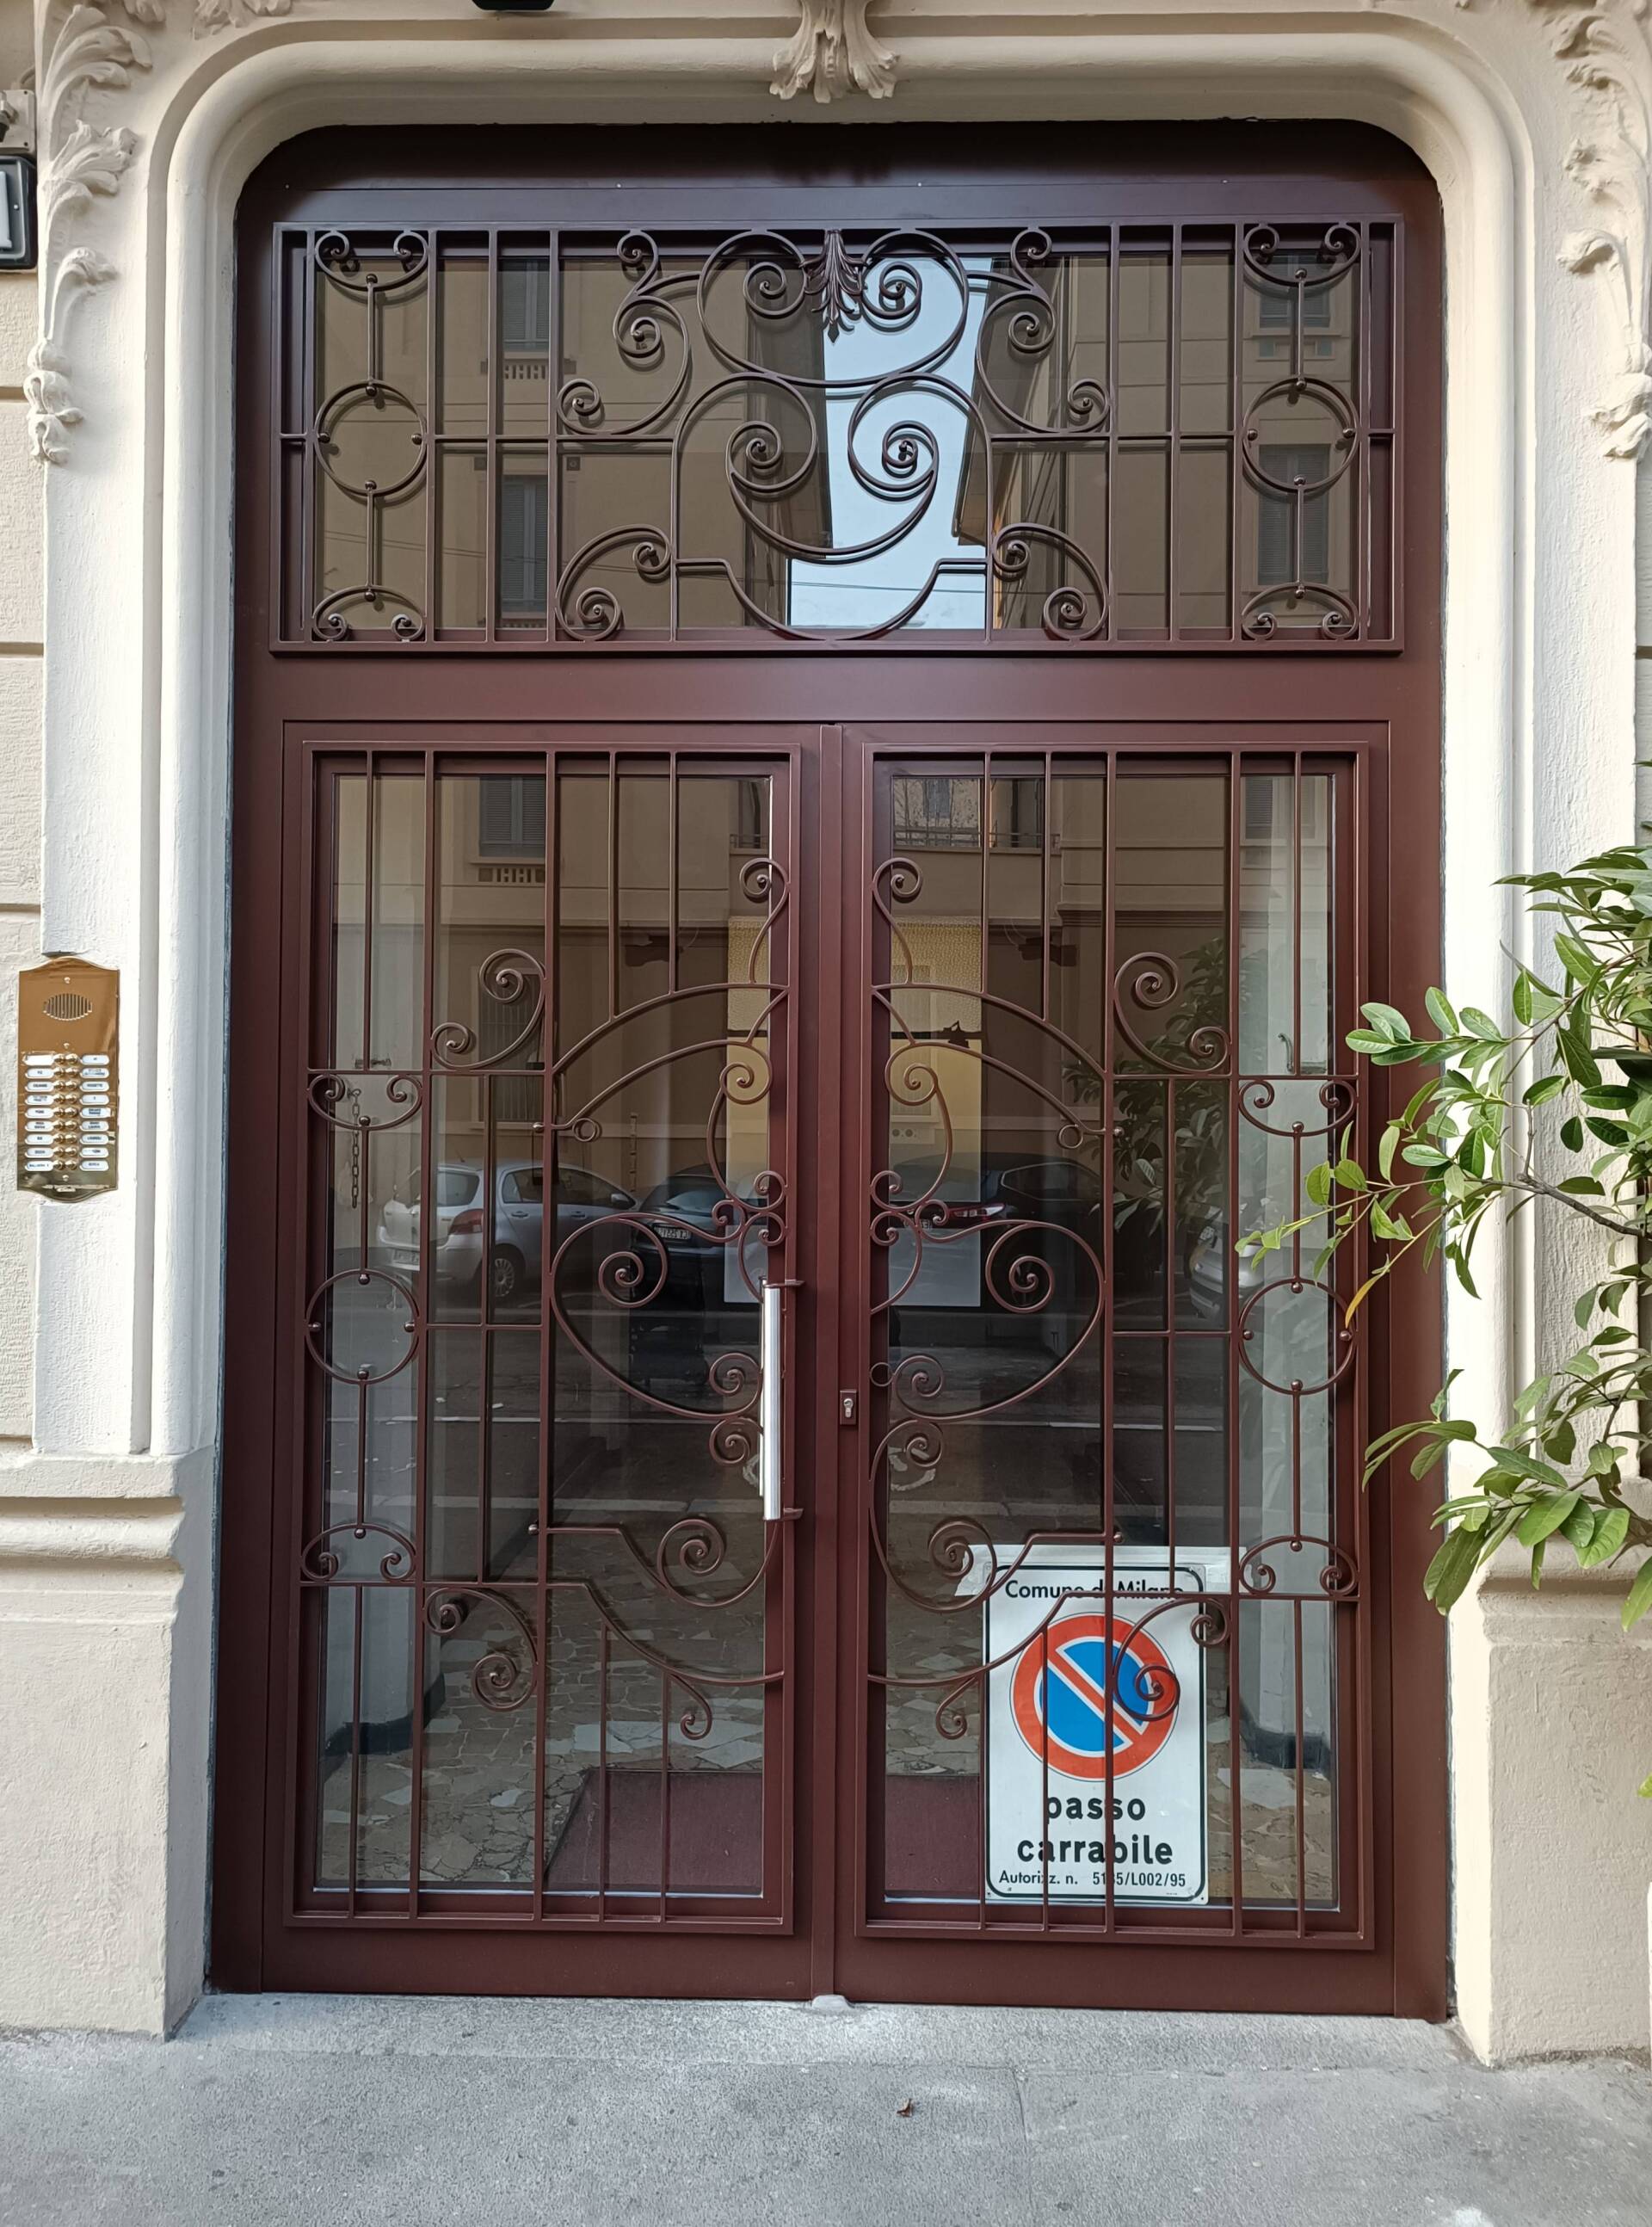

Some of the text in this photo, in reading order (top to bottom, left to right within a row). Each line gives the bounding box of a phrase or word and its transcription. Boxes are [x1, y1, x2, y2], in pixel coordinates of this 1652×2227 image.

[1093, 1579, 1107, 1599] d
[1046, 1797, 1146, 1824] passo
[1017, 1834, 1173, 1865] carrabile
[1066, 1875, 1078, 1885] n.
[1093, 1872, 1186, 1886] 515/L002/95
